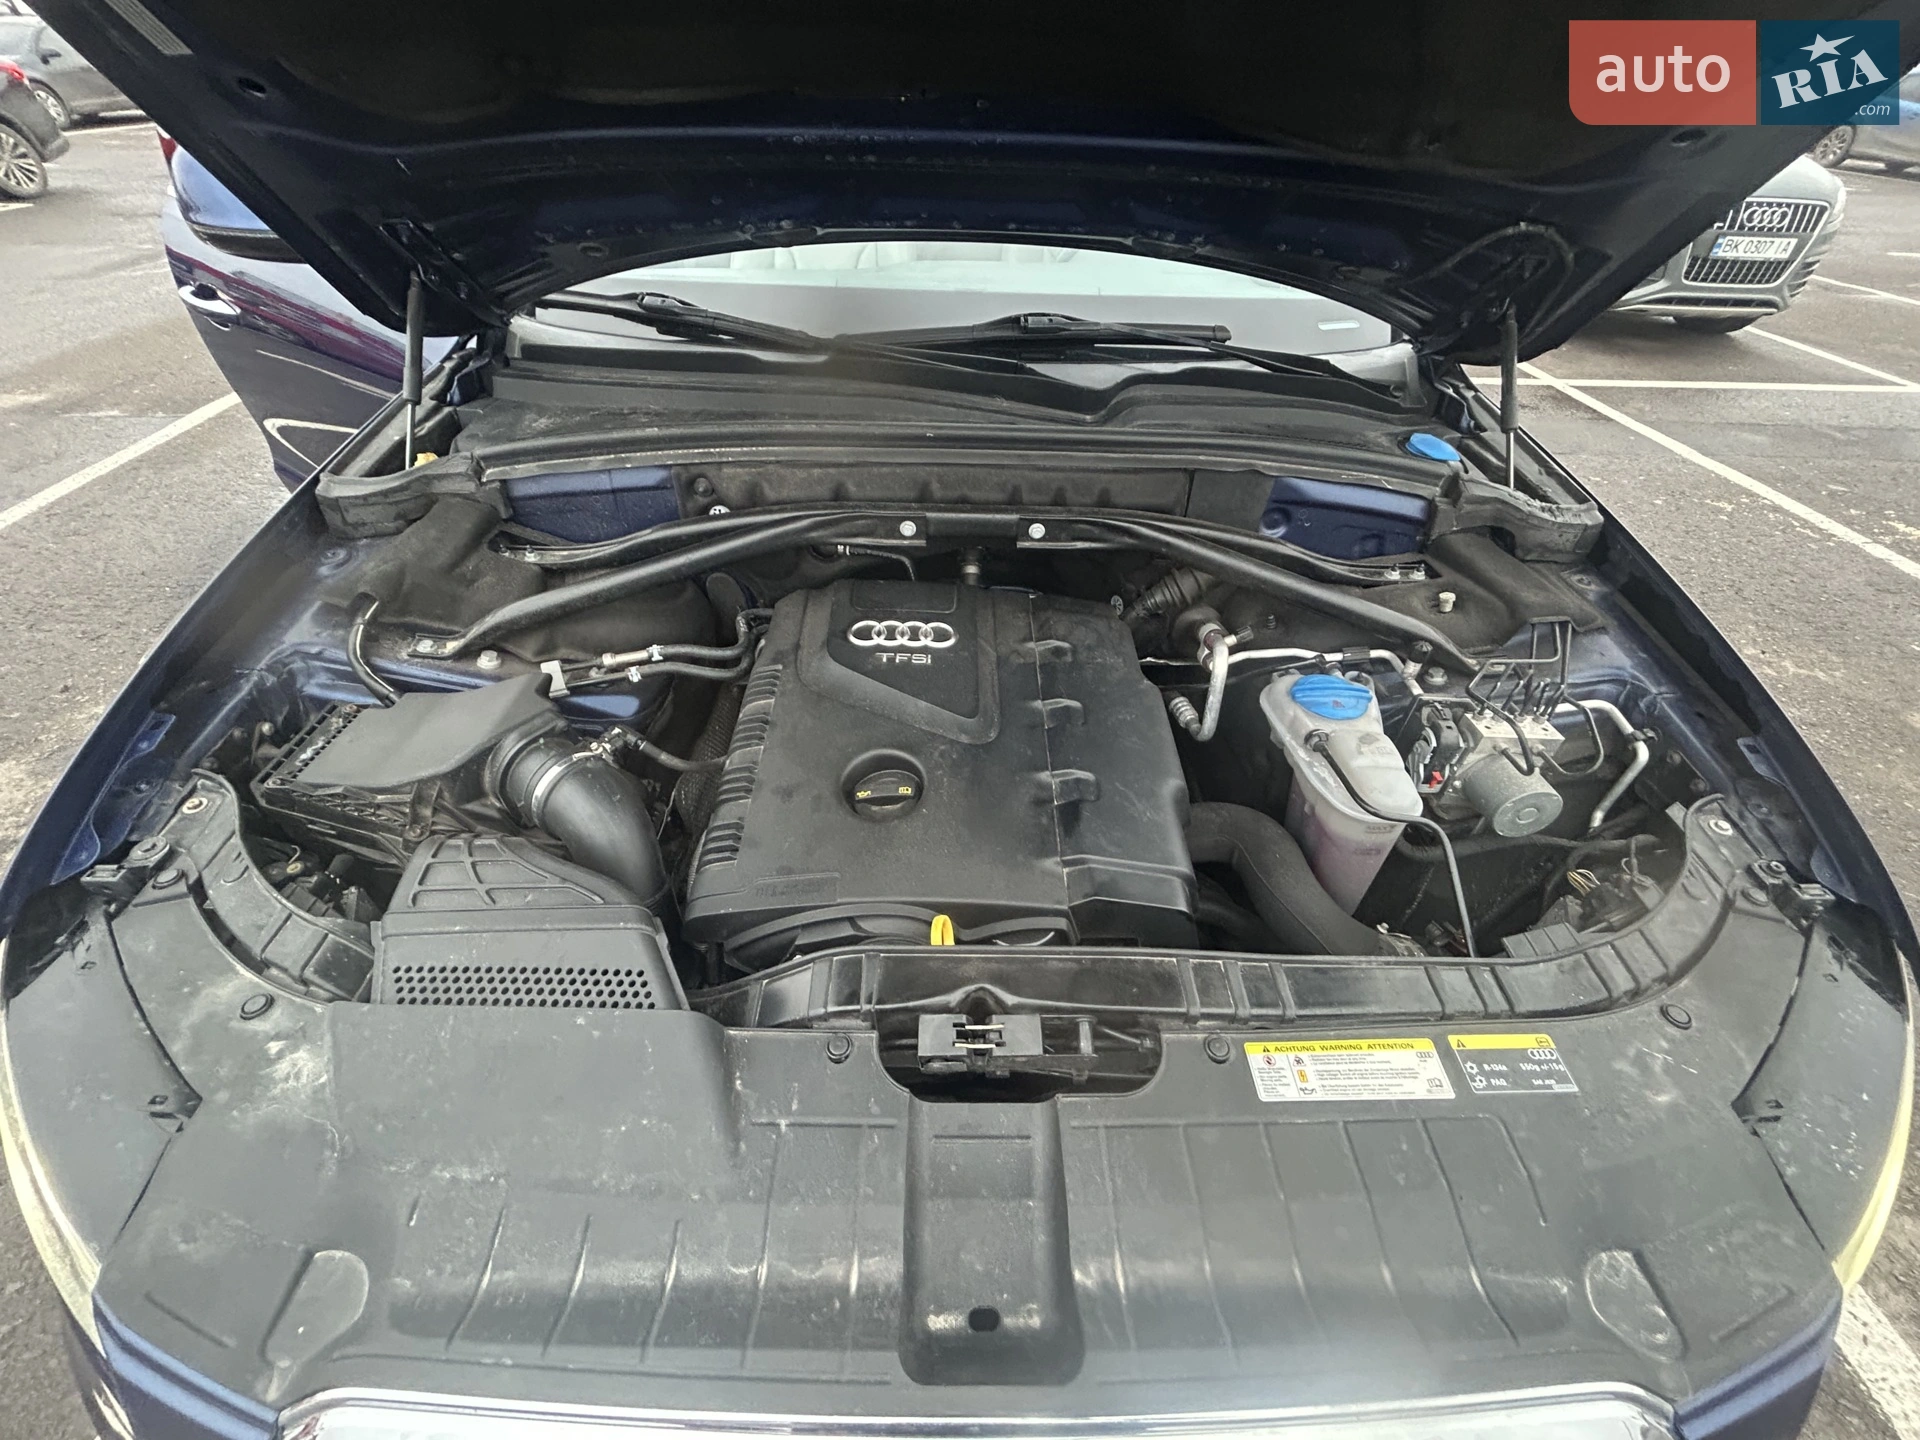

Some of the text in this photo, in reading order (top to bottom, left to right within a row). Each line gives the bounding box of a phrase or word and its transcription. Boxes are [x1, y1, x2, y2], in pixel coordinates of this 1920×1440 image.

[1722, 239, 1745, 254] BK
[1743, 240, 1775, 254] 0307
[875, 652, 932, 664] TFSI
[1274, 1042, 1415, 1053] ACHTUNG WARNING ATTENTION
